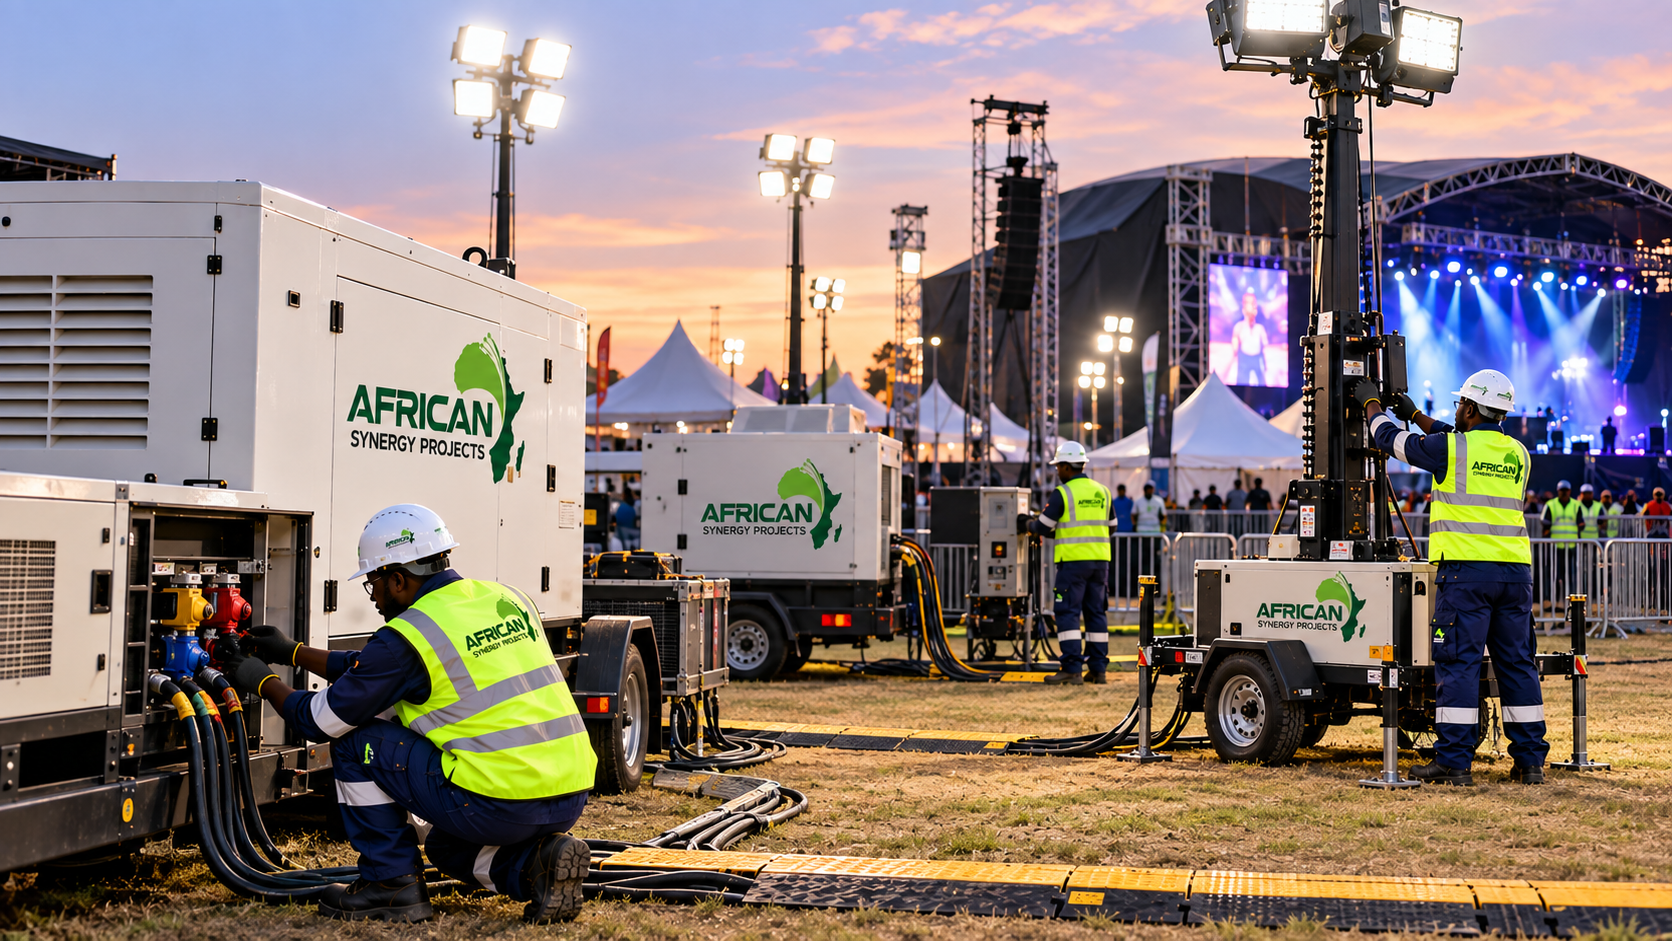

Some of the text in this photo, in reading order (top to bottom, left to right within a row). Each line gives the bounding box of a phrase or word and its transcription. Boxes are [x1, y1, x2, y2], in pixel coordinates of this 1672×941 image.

[346, 384, 493, 437] AFRICAN
[350, 430, 485, 460] SYNERGY PROJECTS
[1471, 461, 1516, 475] AFRICAN
[700, 503, 813, 523] AFRICAN
[703, 526, 807, 535] SYNERGY PROJECTS
[1256, 603, 1343, 622] AFRICAN
[465, 618, 526, 651] AFRICAN
[1257, 620, 1338, 631] SYNERGY PROJECTS
